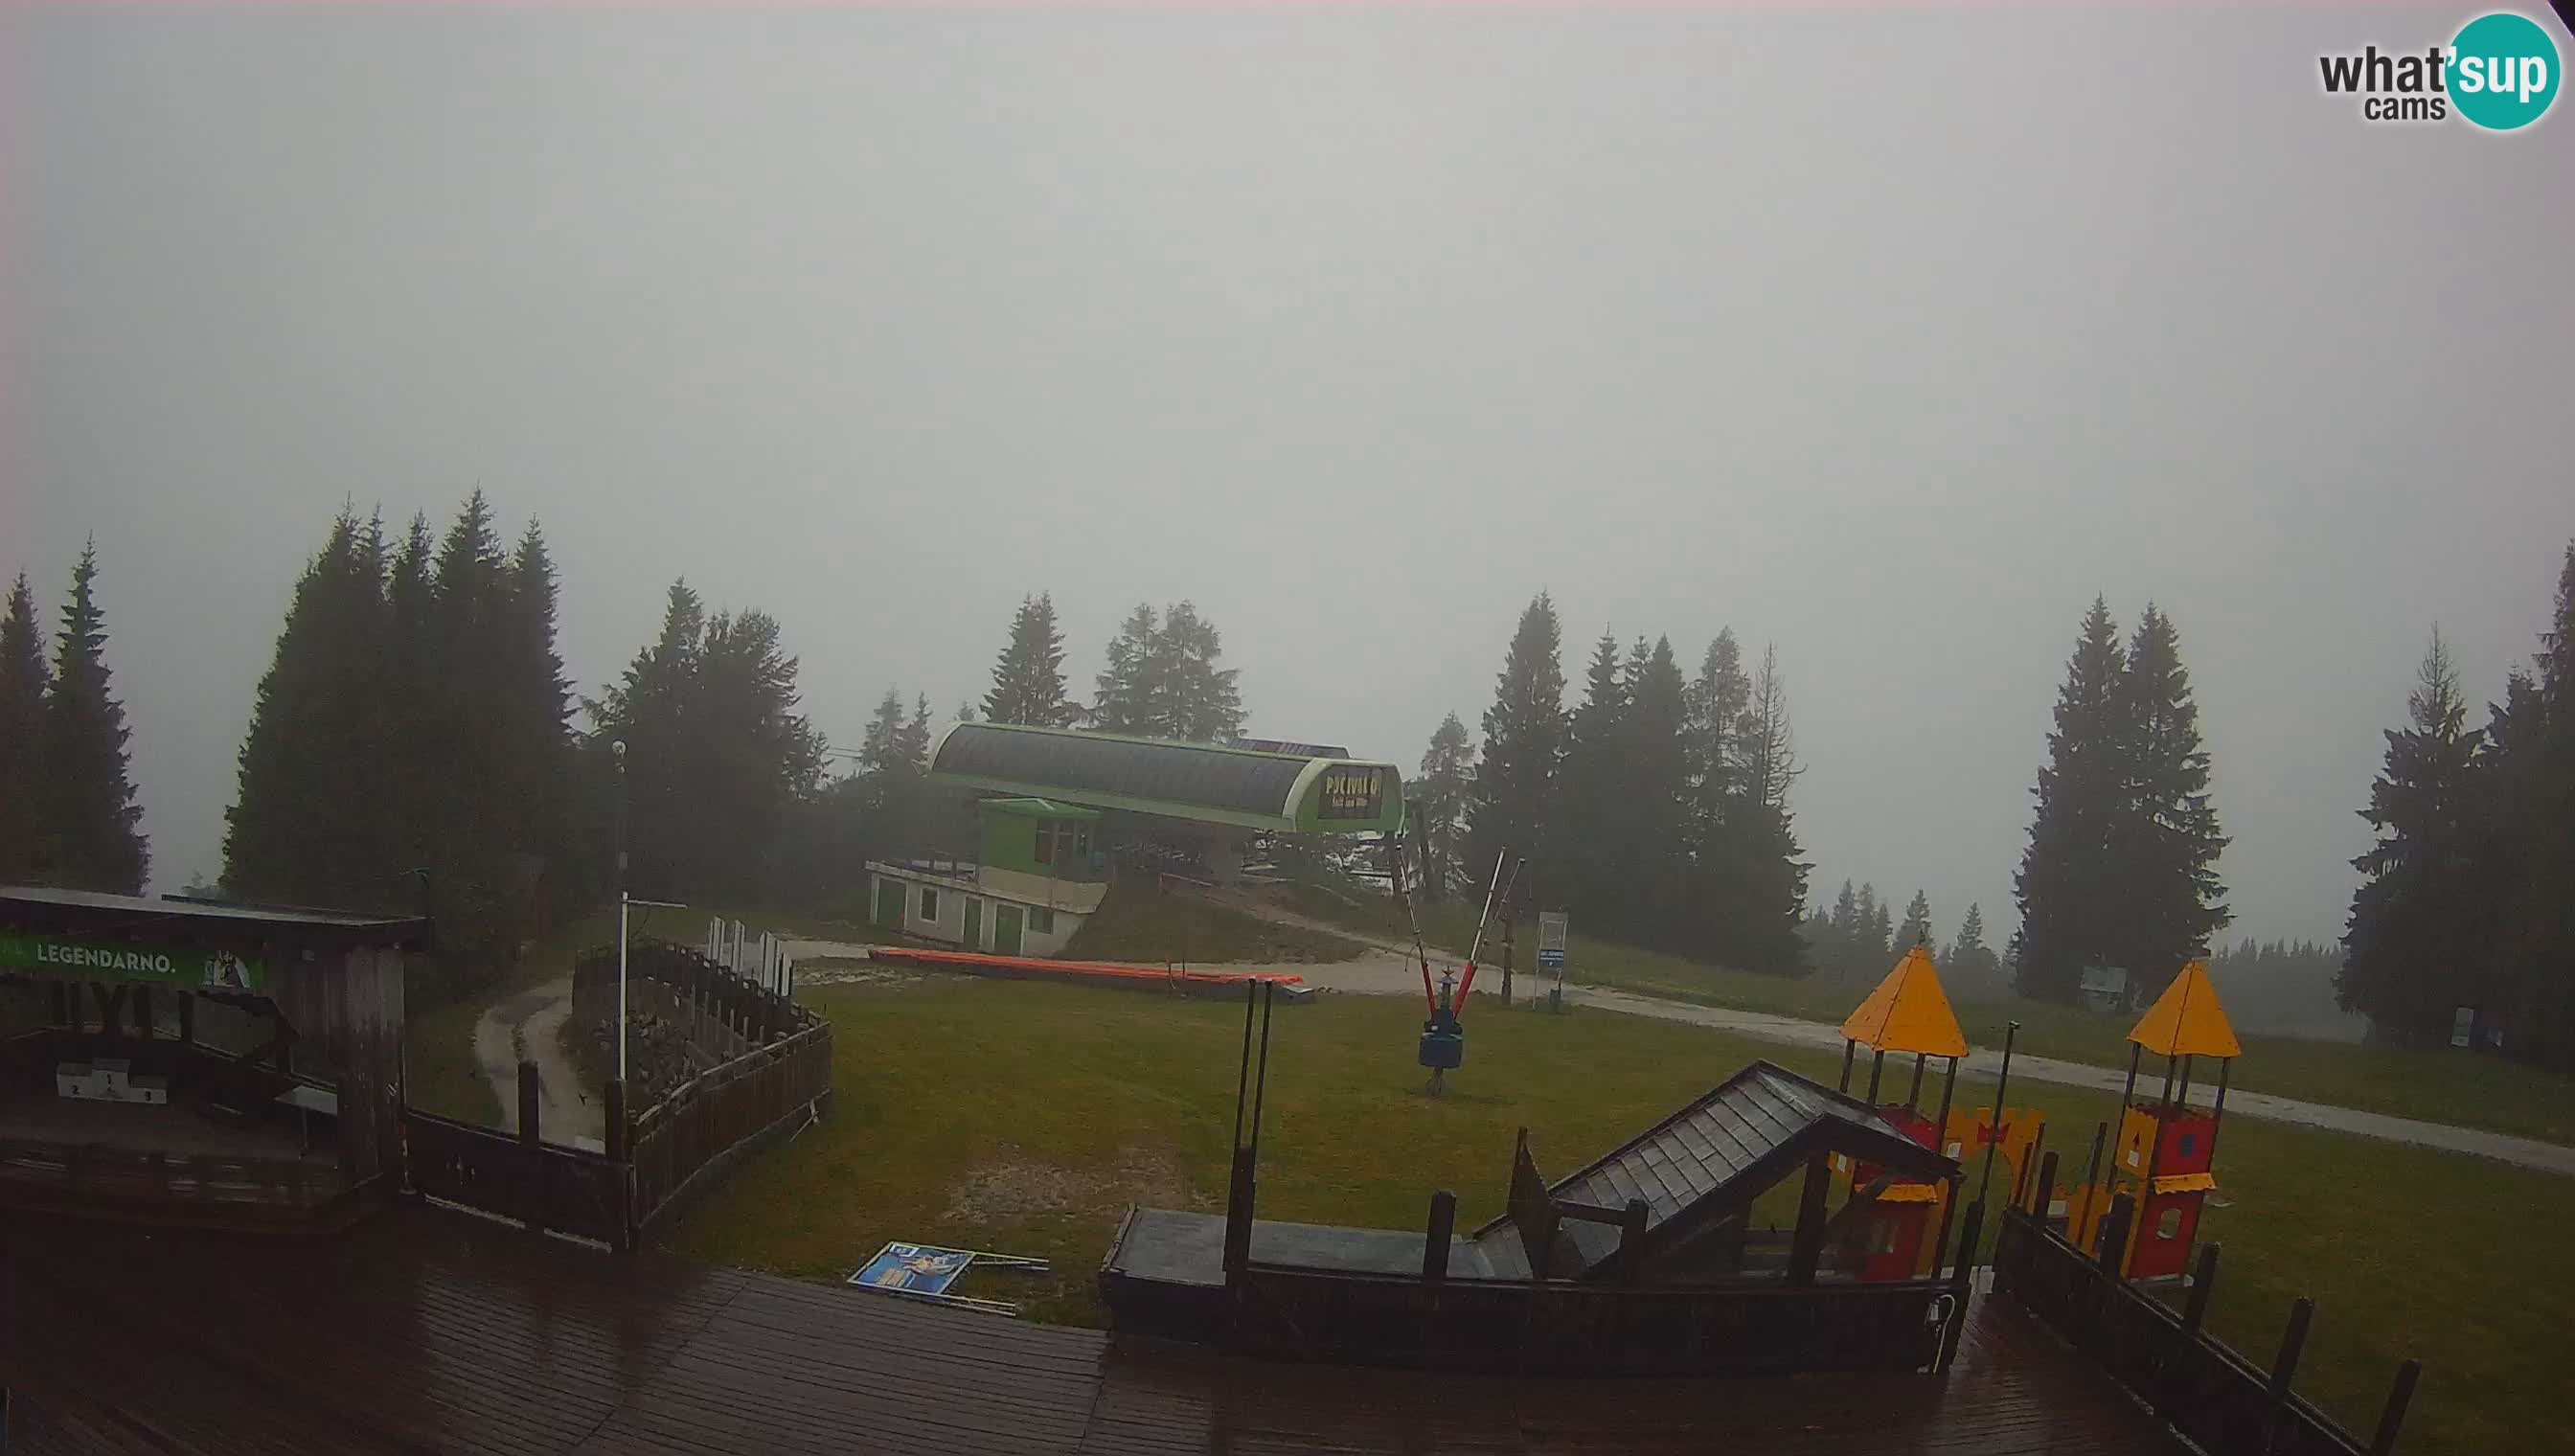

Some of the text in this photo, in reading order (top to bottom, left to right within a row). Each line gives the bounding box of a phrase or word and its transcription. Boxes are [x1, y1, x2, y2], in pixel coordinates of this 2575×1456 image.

[36, 943, 176, 973] LEGENDARNO.
[72, 1084, 80, 1096] 2
[144, 1090, 152, 1102] 3
